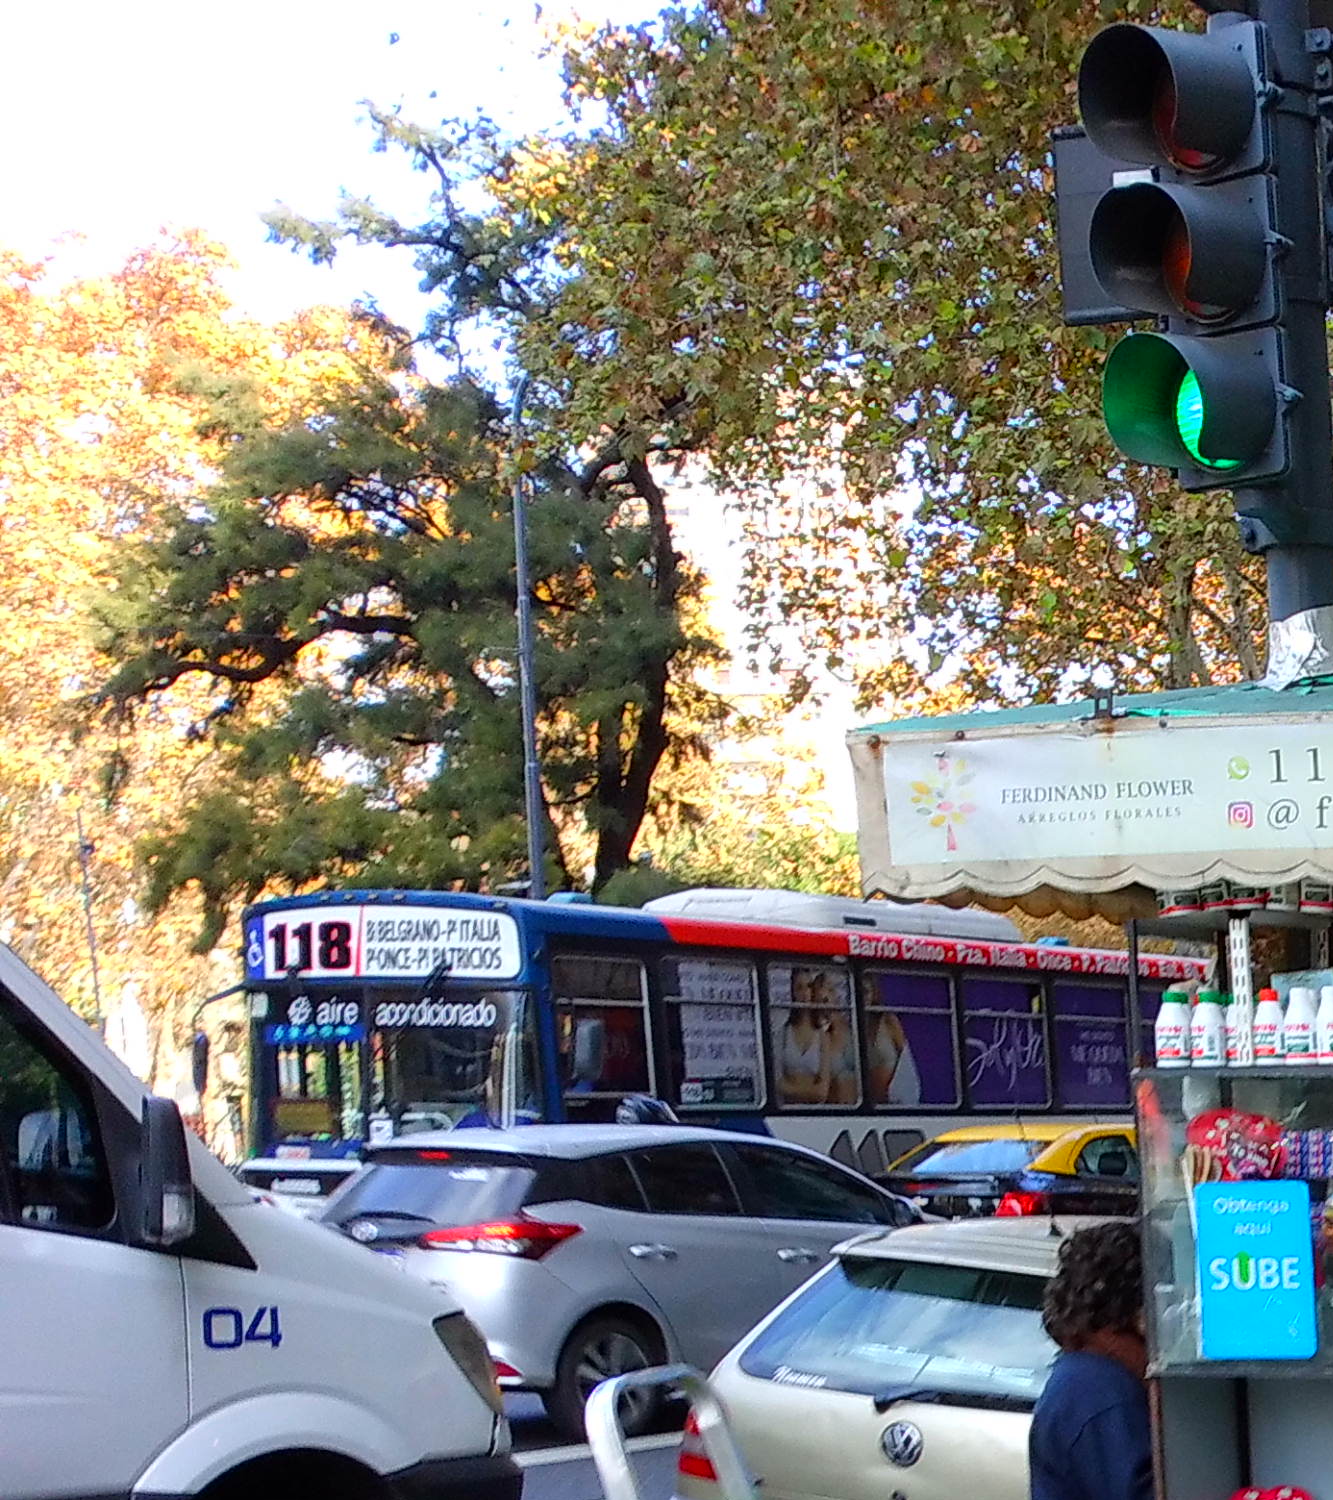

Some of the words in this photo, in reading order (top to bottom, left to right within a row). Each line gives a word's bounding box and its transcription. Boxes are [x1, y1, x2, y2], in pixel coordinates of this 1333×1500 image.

[1268, 746, 1326, 784] 11
[1001, 783, 1107, 805] FERDINAND
[1116, 779, 1195, 800] FLOWER
[1017, 810, 1097, 825] ARREGLOS
[1105, 806, 1182, 821] FLORALES
[268, 920, 353, 973] 118
[460, 919, 501, 942] ITALIA
[847, 934, 899, 959] Barrio
[900, 938, 945, 962] Chino
[1036, 951, 1072, 971] Once
[315, 997, 359, 1027] aire
[1212, 1196, 1290, 1216] Obtenga
[1208, 1255, 1301, 1291] SUBE
[202, 1305, 283, 1349] 04
